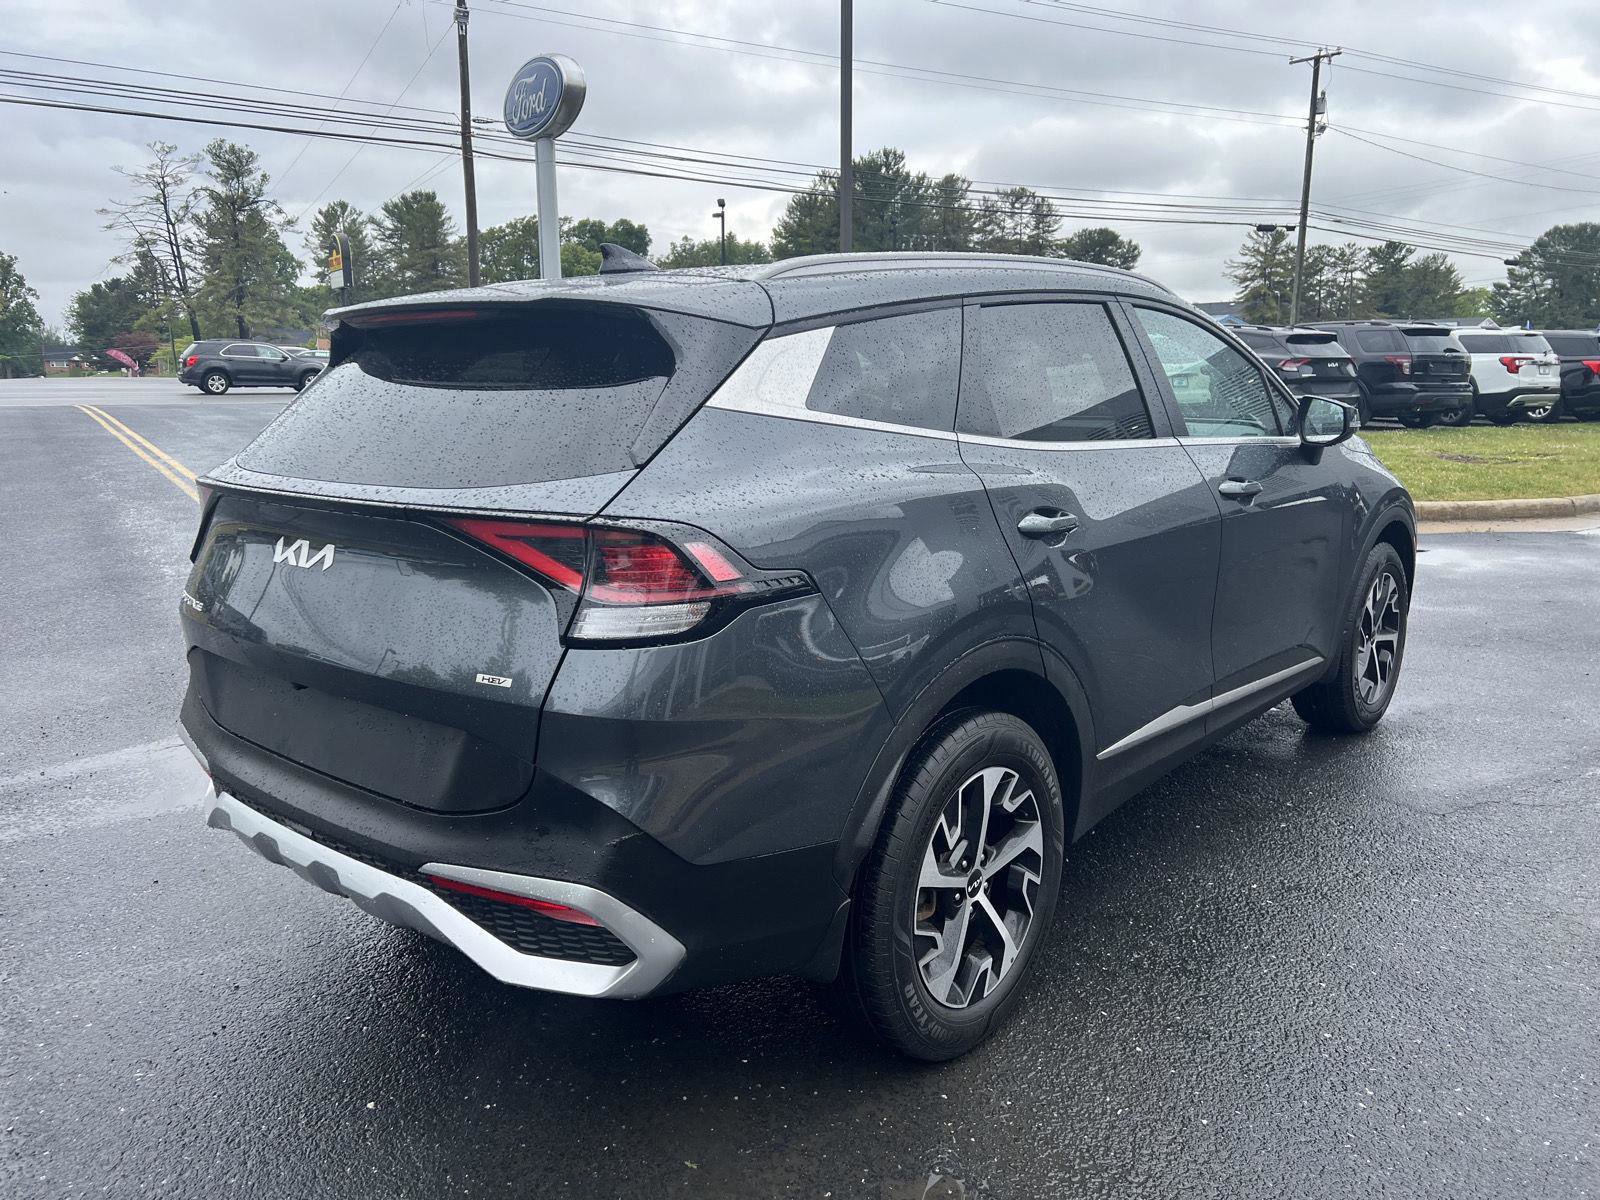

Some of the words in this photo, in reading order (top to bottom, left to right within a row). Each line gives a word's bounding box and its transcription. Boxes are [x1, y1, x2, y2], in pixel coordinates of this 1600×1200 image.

[512, 73, 547, 124] Ford
[273, 536, 335, 572] KIA
[479, 675, 508, 685] HEV
[1017, 740, 1060, 808] SSURANCE
